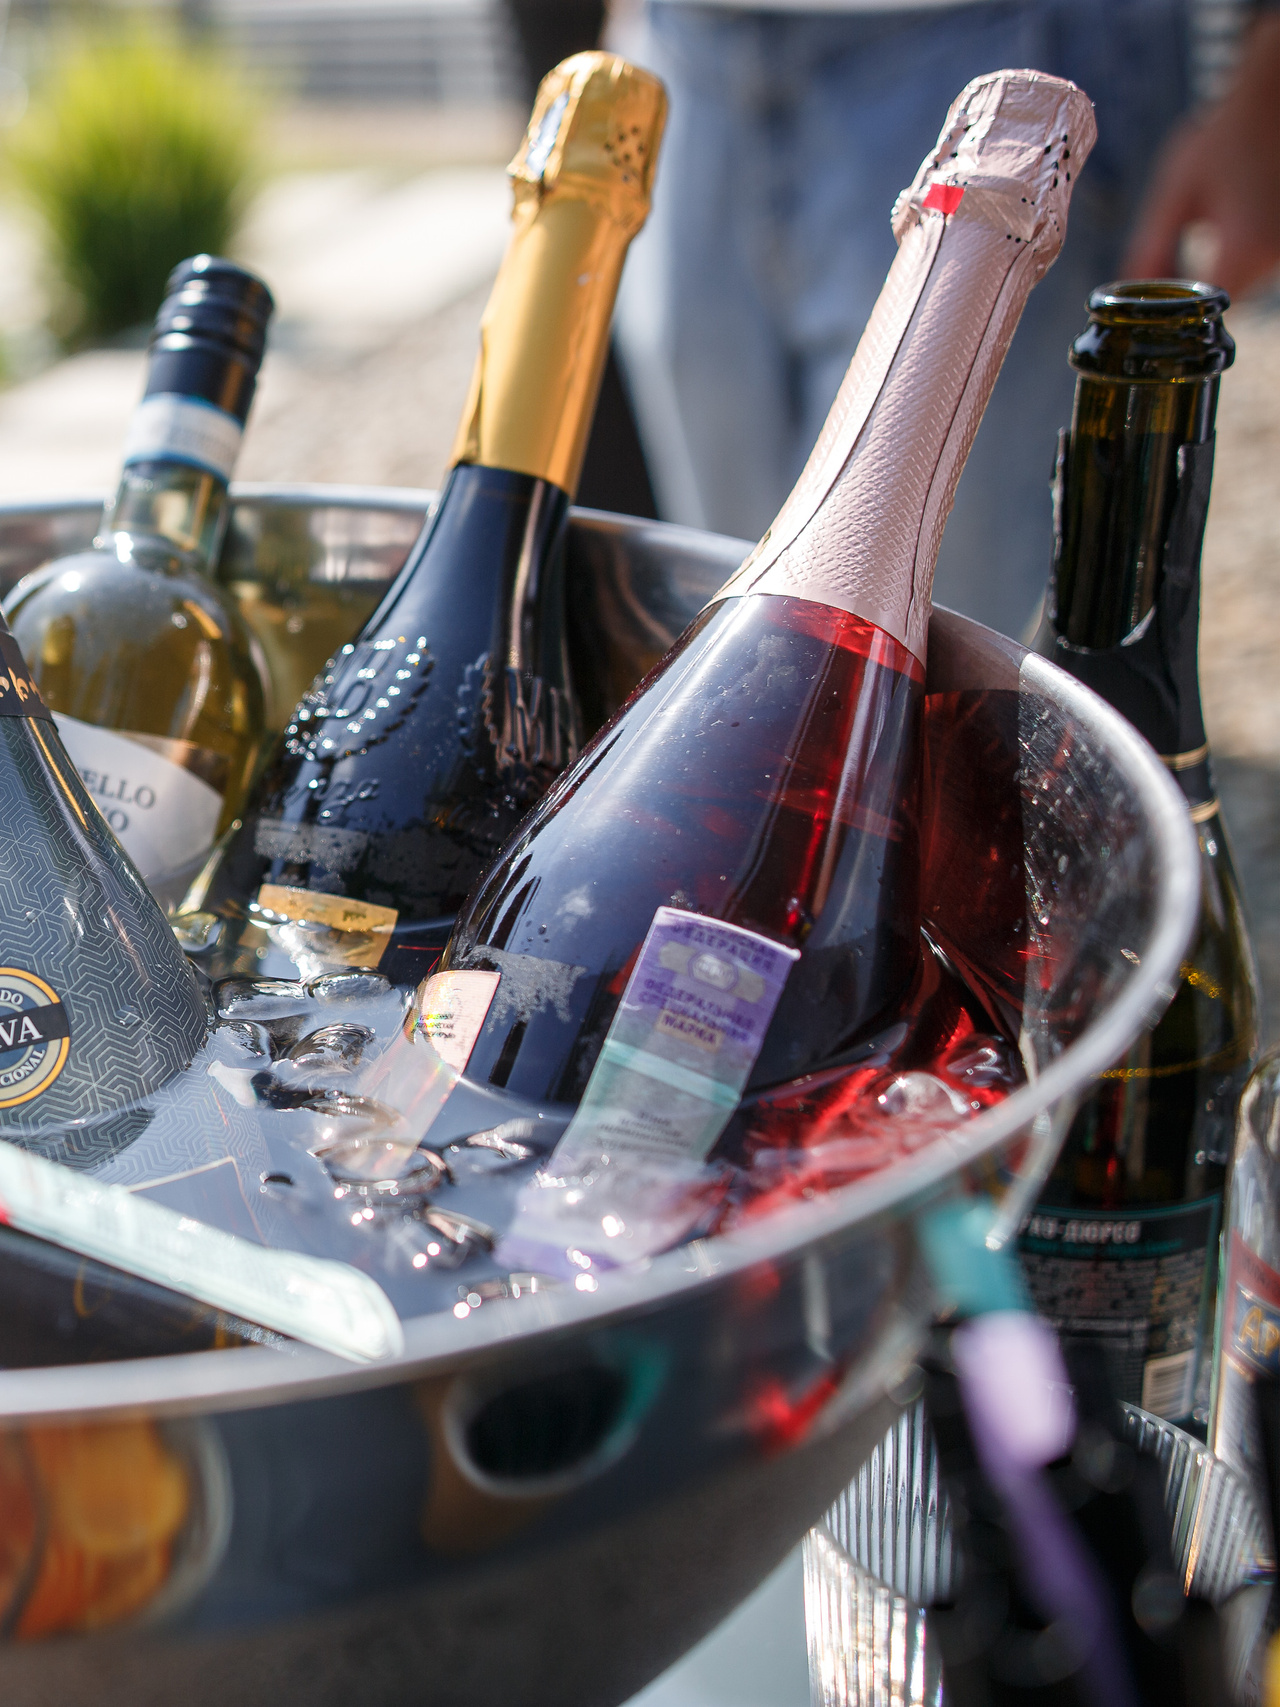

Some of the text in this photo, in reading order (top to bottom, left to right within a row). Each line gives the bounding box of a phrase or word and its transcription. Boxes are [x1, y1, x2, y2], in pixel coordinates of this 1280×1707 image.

[78, 768, 156, 809] ELLO
[103, 806, 129, 832] O
[1238, 1306, 1280, 1358] AP
